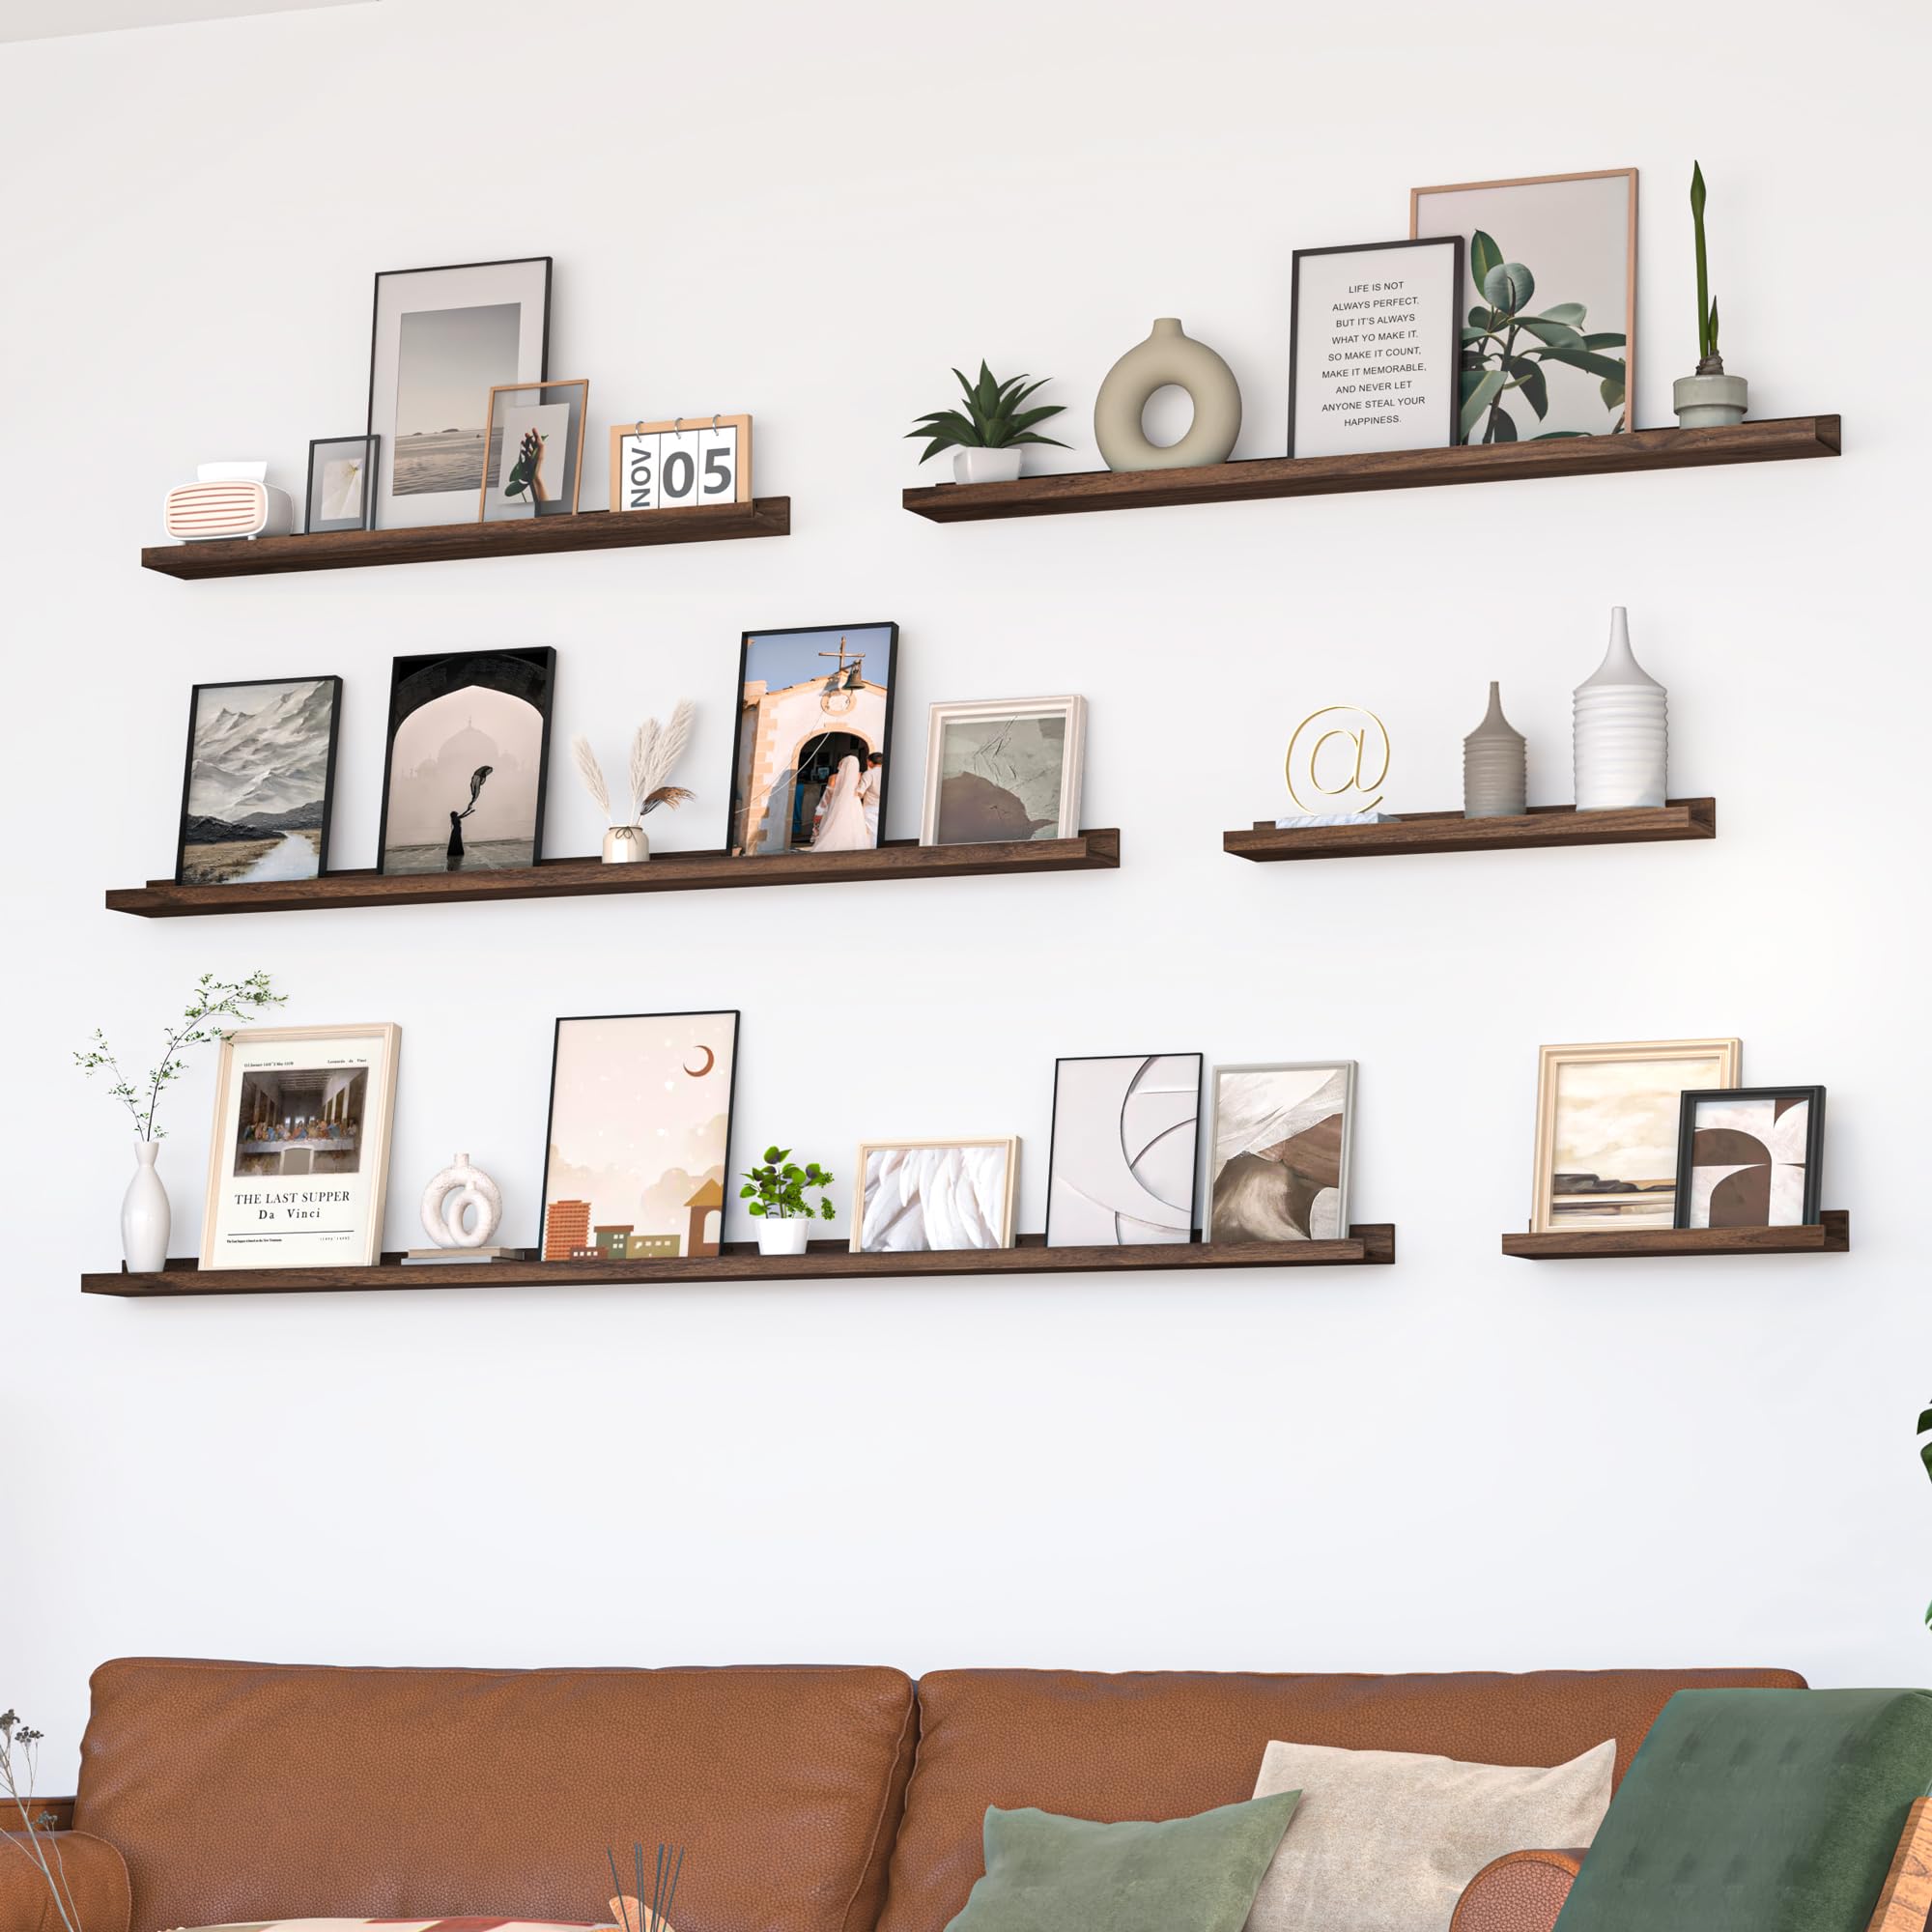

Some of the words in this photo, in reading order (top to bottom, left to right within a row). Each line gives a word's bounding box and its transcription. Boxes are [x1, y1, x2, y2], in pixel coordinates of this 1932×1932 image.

[1349, 284, 1369, 294] LIFE
[1372, 283, 1381, 292] IS
[1383, 281, 1405, 291] NOT
[1332, 300, 1371, 311] ALWAYS
[1373, 297, 1419, 308] PERFECT.
[1336, 319, 1354, 328] BUT
[1357, 317, 1375, 326] IT'S
[1377, 313, 1415, 324] ALWAYS
[1331, 335, 1359, 345] WHAT
[1362, 333, 1376, 342] YO
[1378, 331, 1405, 341] MAKE
[1328, 353, 1342, 361] SO
[1345, 351, 1371, 360] MAKE
[1374, 349, 1383, 357] IT
[1321, 369, 1349, 379] MAKE
[1351, 368, 1360, 377] IT
[1336, 385, 1355, 394] AND
[1358, 382, 1392, 392] NEVER
[1394, 380, 1412, 389] LET
[1321, 401, 1362, 412] ANYONE
[1365, 399, 1395, 409] STEAL
[1398, 396, 1426, 406] YOUR
[1344, 414, 1402, 427] HAPPINESS.
[631, 447, 651, 508] NOV
[234, 1194, 262, 1205] THE
[266, 1192, 298, 1204] LAST
[301, 1190, 350, 1203] SUPPER
[258, 1209, 275, 1220] Da
[287, 1208, 321, 1219] Vinci
